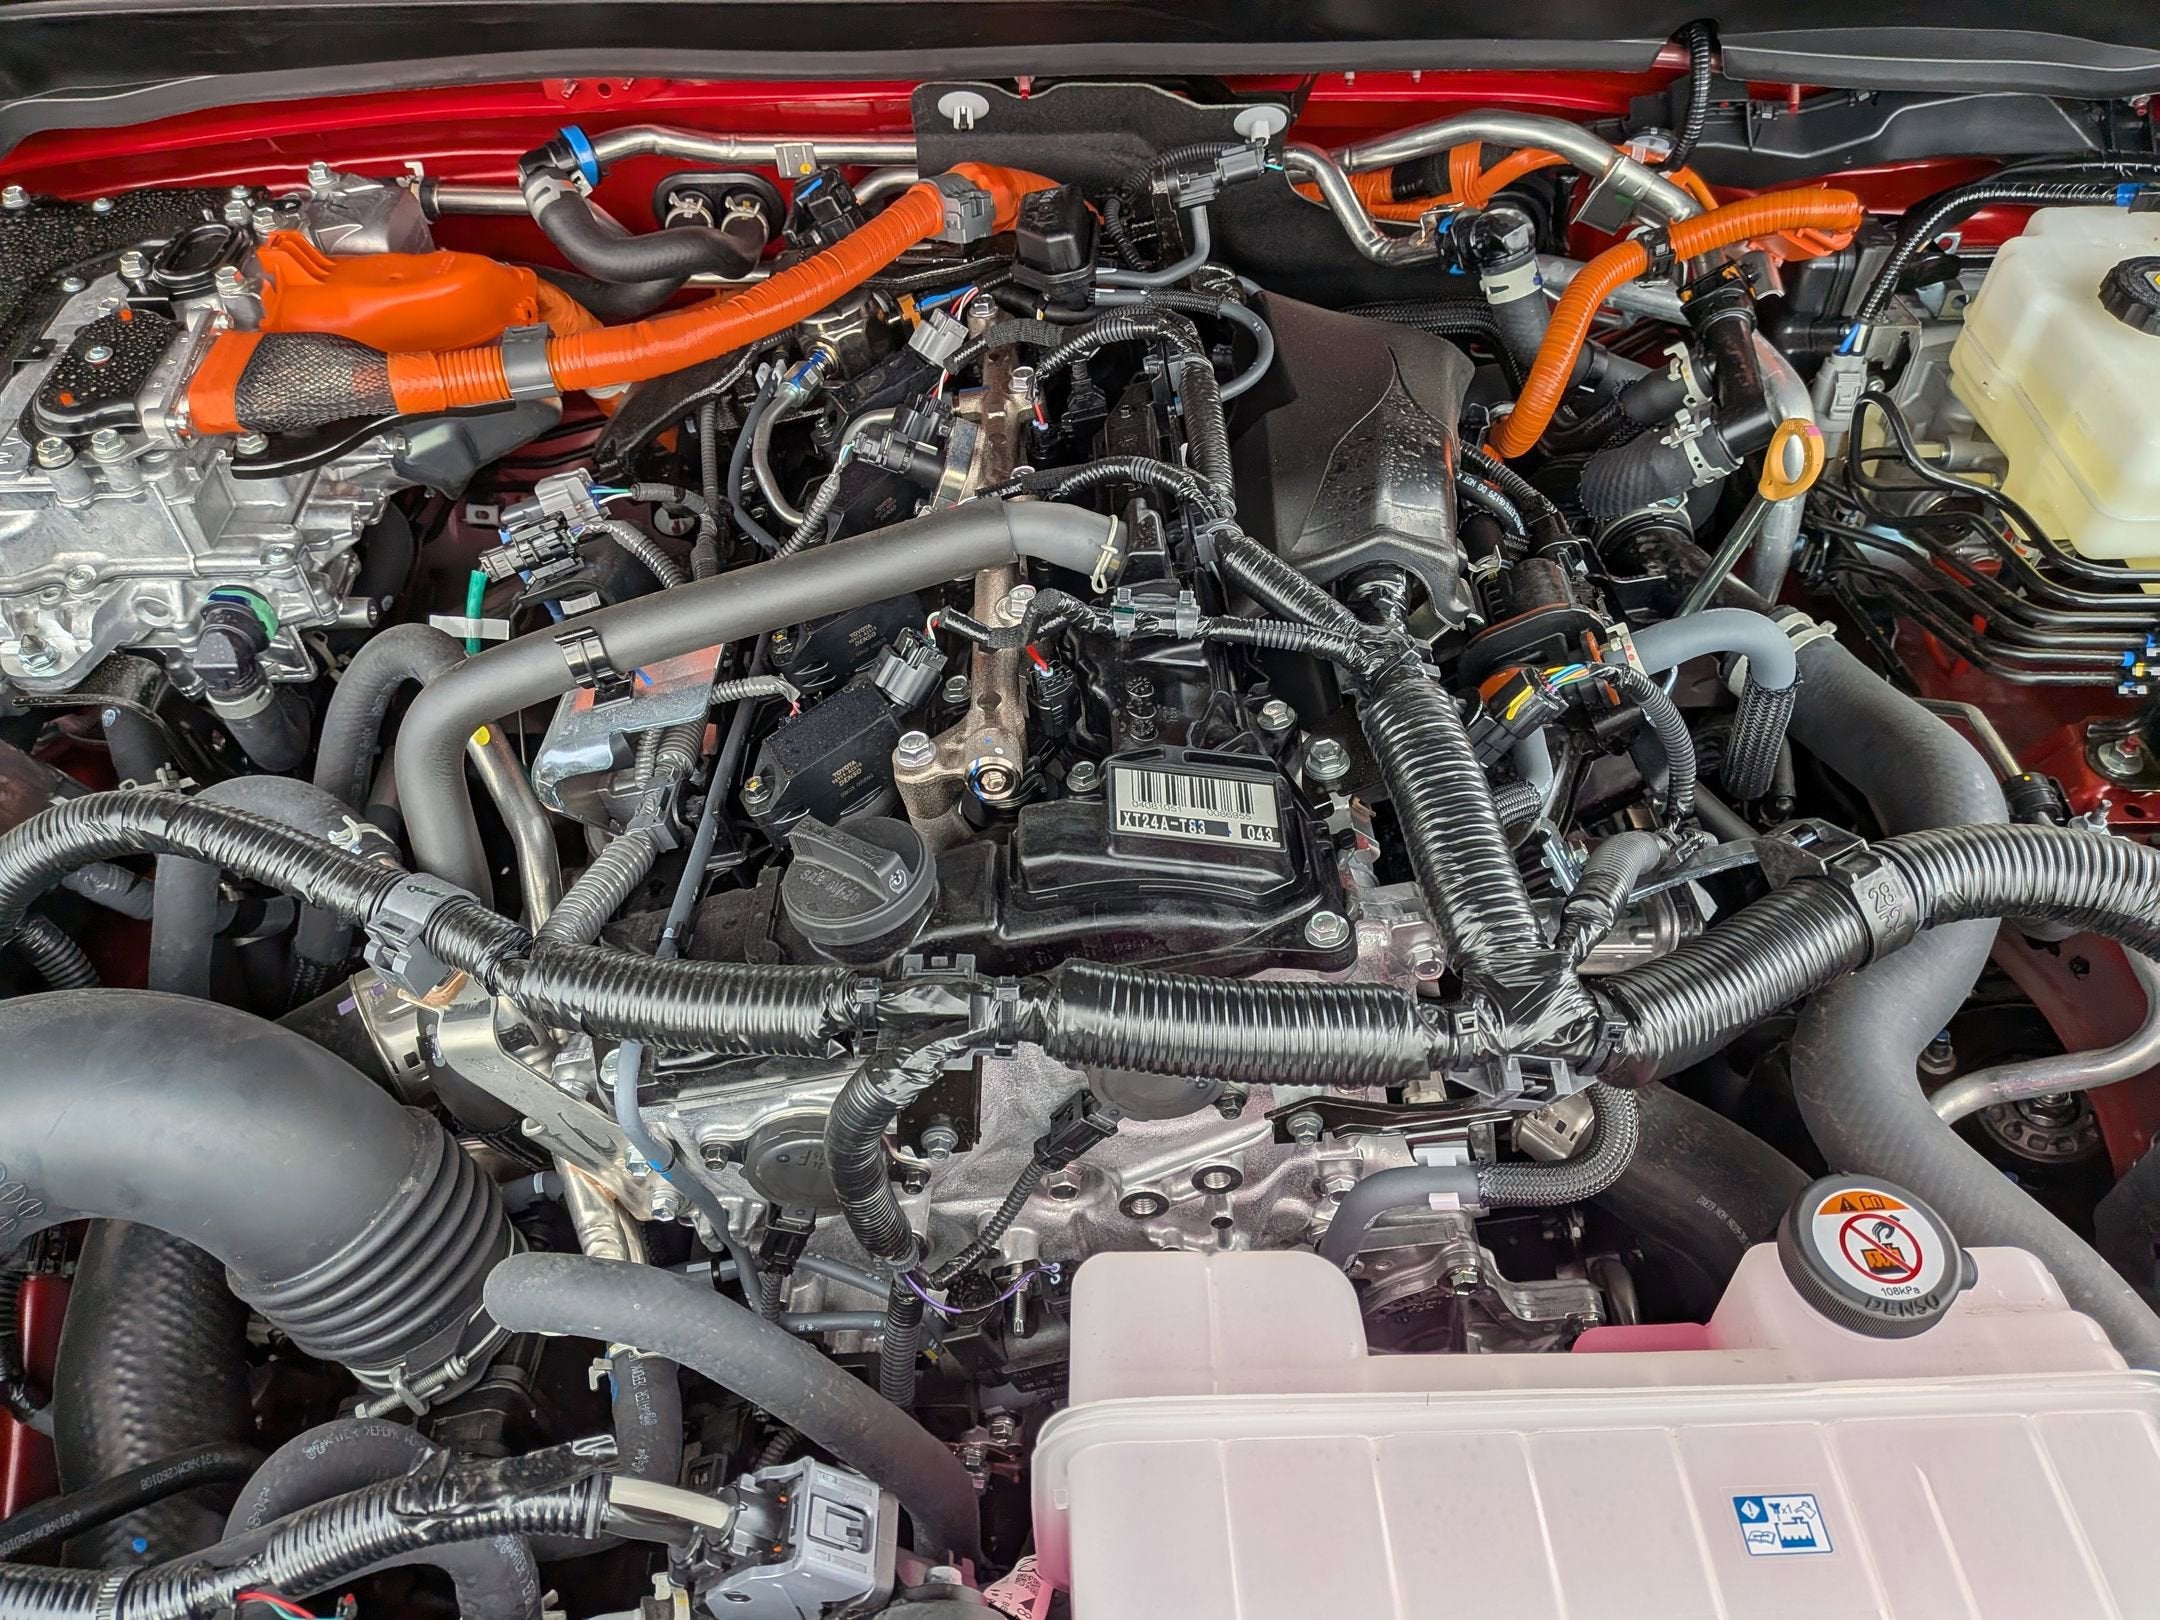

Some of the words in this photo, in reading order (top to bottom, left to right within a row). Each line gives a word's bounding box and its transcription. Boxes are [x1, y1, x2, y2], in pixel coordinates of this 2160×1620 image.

[1463, 475, 1477, 488] NOT
[1477, 483, 1488, 494] DO
[848, 623, 873, 639] TOYOTA
[832, 760, 858, 777] TOYOTA
[839, 768, 862, 787] DENSO
[1122, 811, 1206, 836] XT24A-T83
[1246, 826, 1273, 842] 043
[799, 869, 825, 887] SAE
[1867, 880, 1896, 914] 28
[1880, 1285, 1921, 1297] 108kPa
[1864, 1293, 1940, 1317] DENSO
